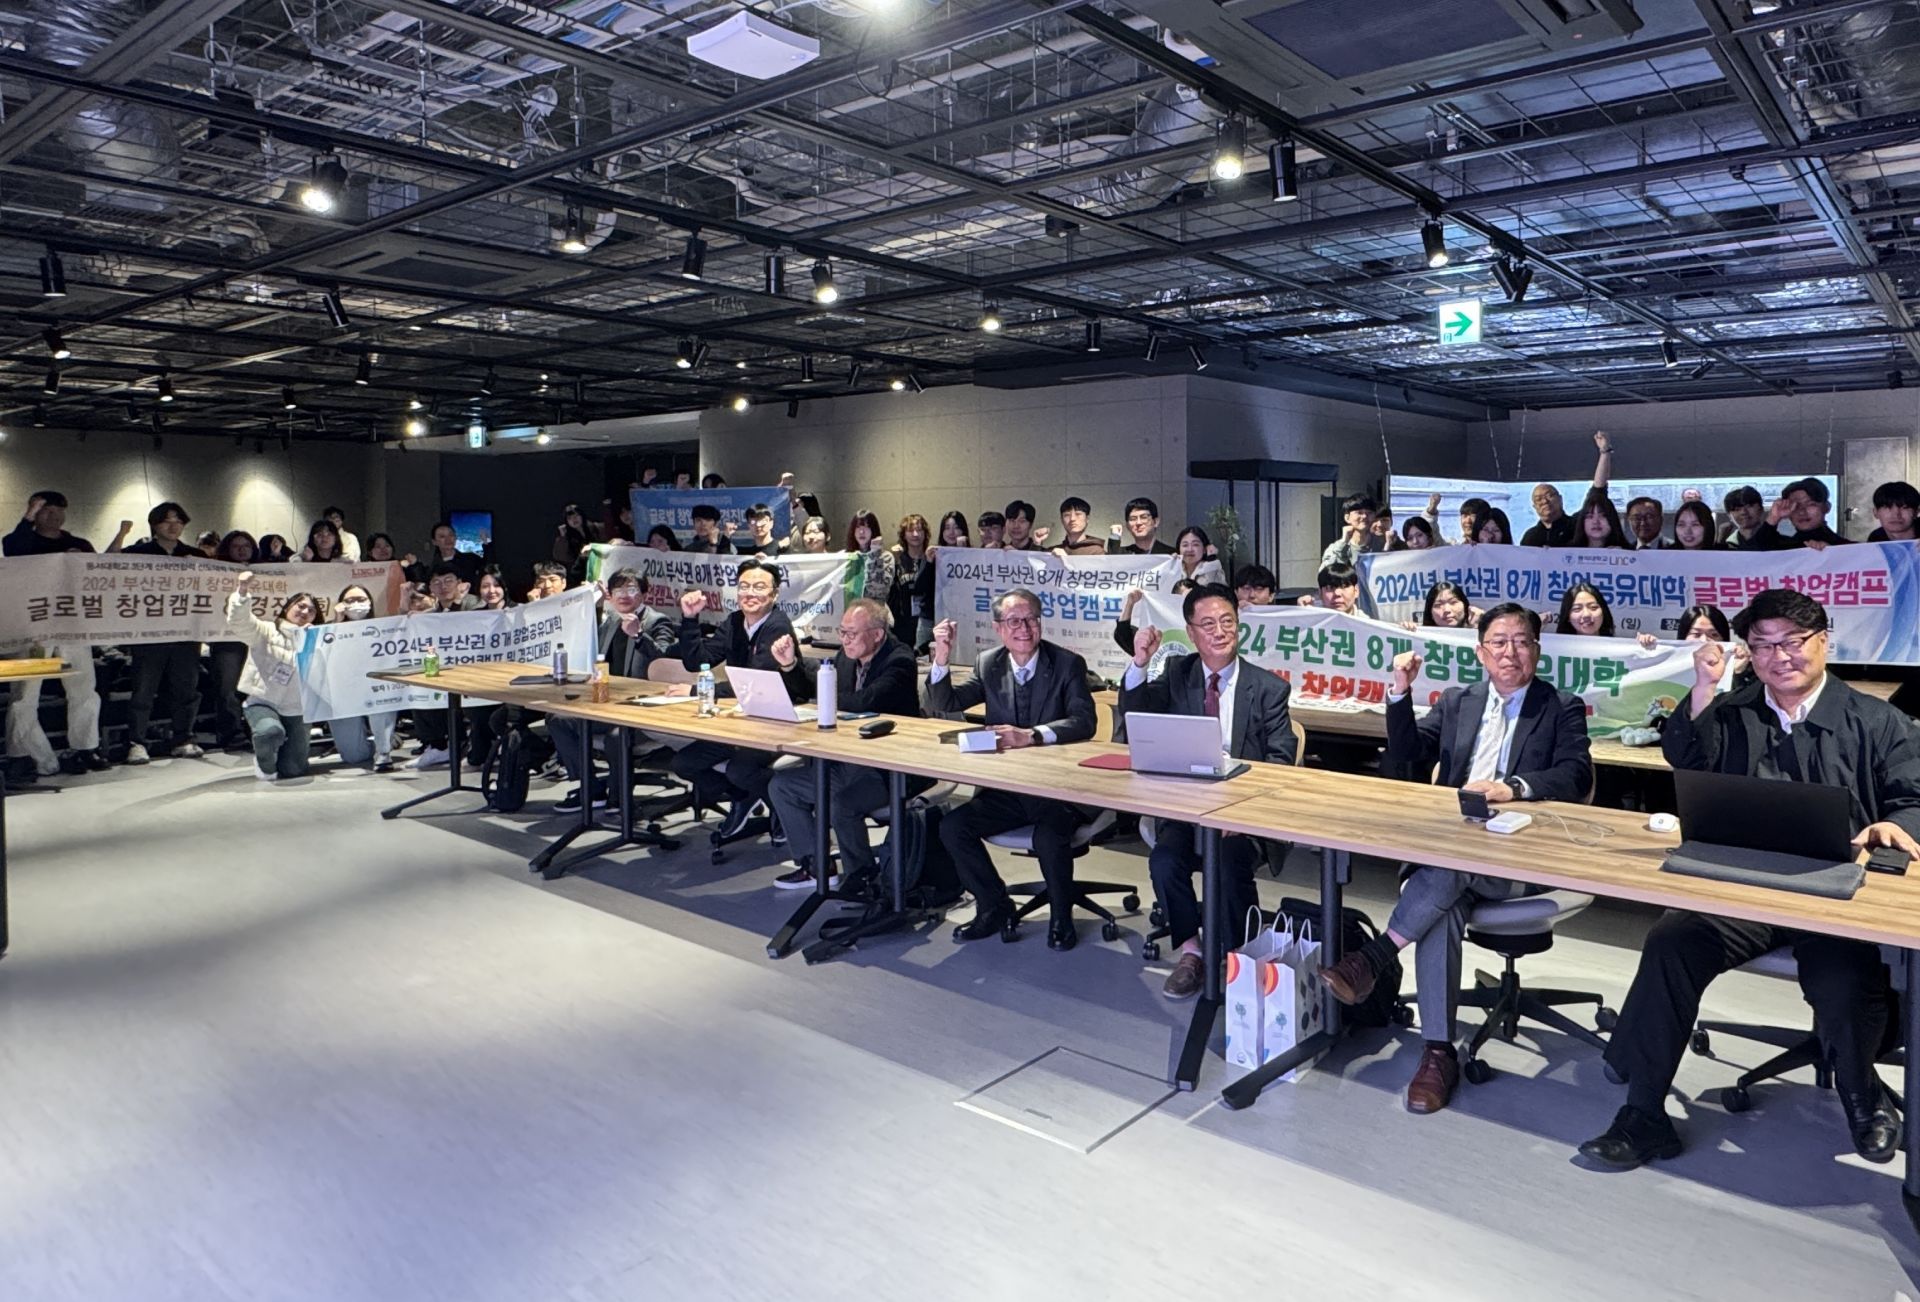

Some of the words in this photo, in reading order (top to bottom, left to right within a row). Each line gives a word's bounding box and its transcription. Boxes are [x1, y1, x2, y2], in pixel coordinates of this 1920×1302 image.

[82, 576, 117, 592] 2024
[122, 576, 172, 592] 부산권
[177, 577, 200, 592] 8개
[206, 577, 288, 594] 창업유대학
[695, 564, 712, 586] 8개
[713, 564, 790, 588] 창업학
[946, 562, 993, 582] 2024년
[997, 564, 1035, 586] 부산권
[1037, 569, 1064, 587] 8개
[1066, 569, 1162, 591] 창업공유대학
[1507, 570, 1541, 601] 8개
[27, 594, 105, 623] 글로벌
[115, 593, 214, 619] 창업캠프
[251, 595, 331, 618] 경진회
[1037, 590, 1123, 622] 창업캠프
[370, 636, 433, 658] 2024년
[438, 633, 486, 652] 부산권
[490, 630, 512, 649] 8개
[513, 615, 563, 646] 창업공유대학
[1621, 617, 1641, 631] (일)
[1238, 622, 1267, 656] 24
[1275, 624, 1355, 667] 부산권
[1367, 634, 1413, 673] 8개
[1424, 639, 1630, 697] 창업대학
